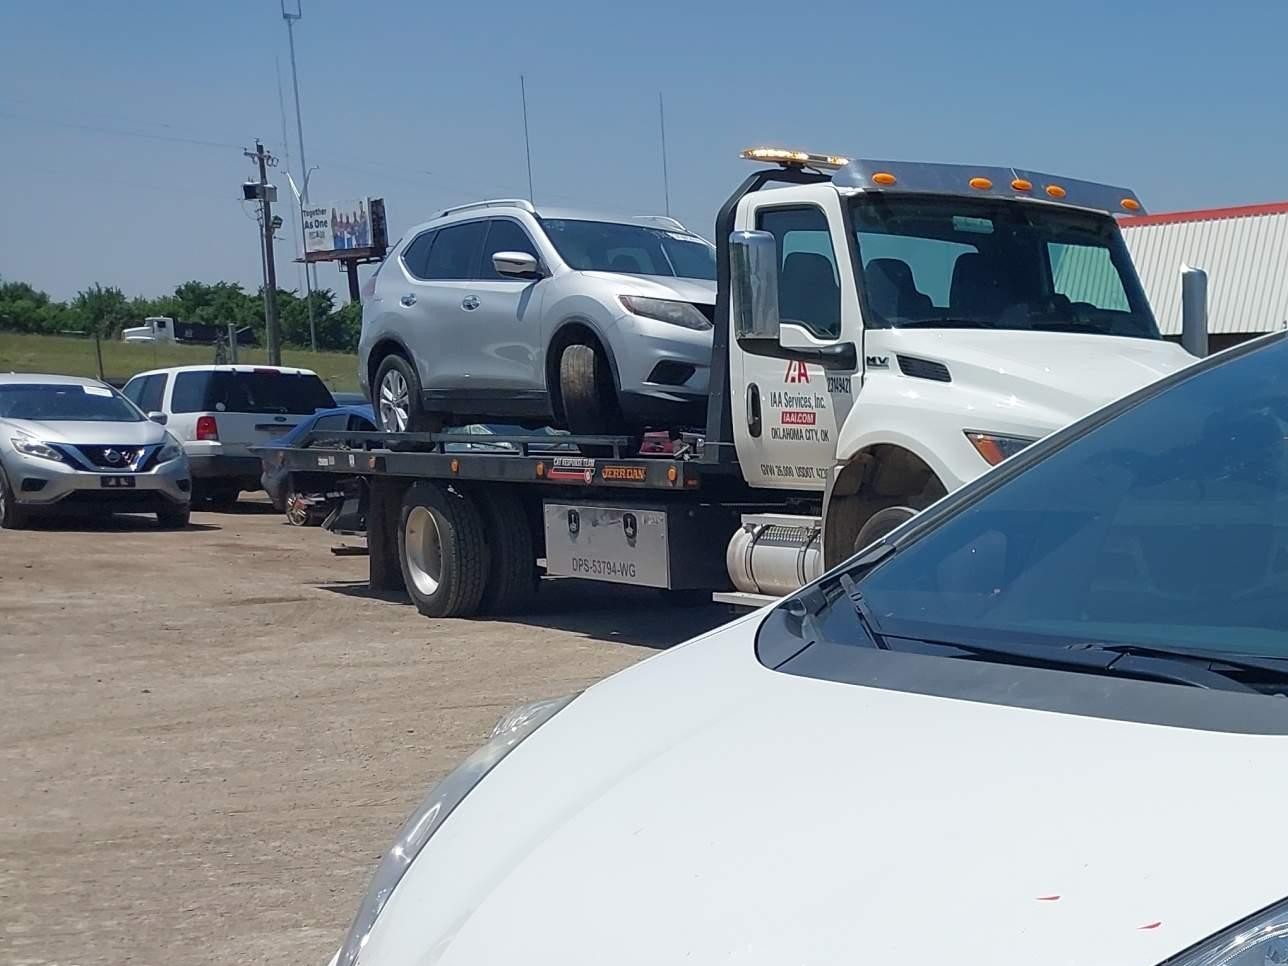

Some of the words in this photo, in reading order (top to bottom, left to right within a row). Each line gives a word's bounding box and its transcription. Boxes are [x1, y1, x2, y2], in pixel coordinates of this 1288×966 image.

[303, 208, 327, 218] Together
[304, 221, 313, 229] As
[314, 219, 328, 228] One
[866, 356, 889, 364] MV
[770, 391, 782, 408] IAA
[784, 392, 814, 410] Services,
[814, 393, 826, 408] Inc.
[771, 427, 804, 440] OKLAHOMA
[820, 429, 829, 441] OK
[572, 558, 636, 577] DPS-53794-WG
